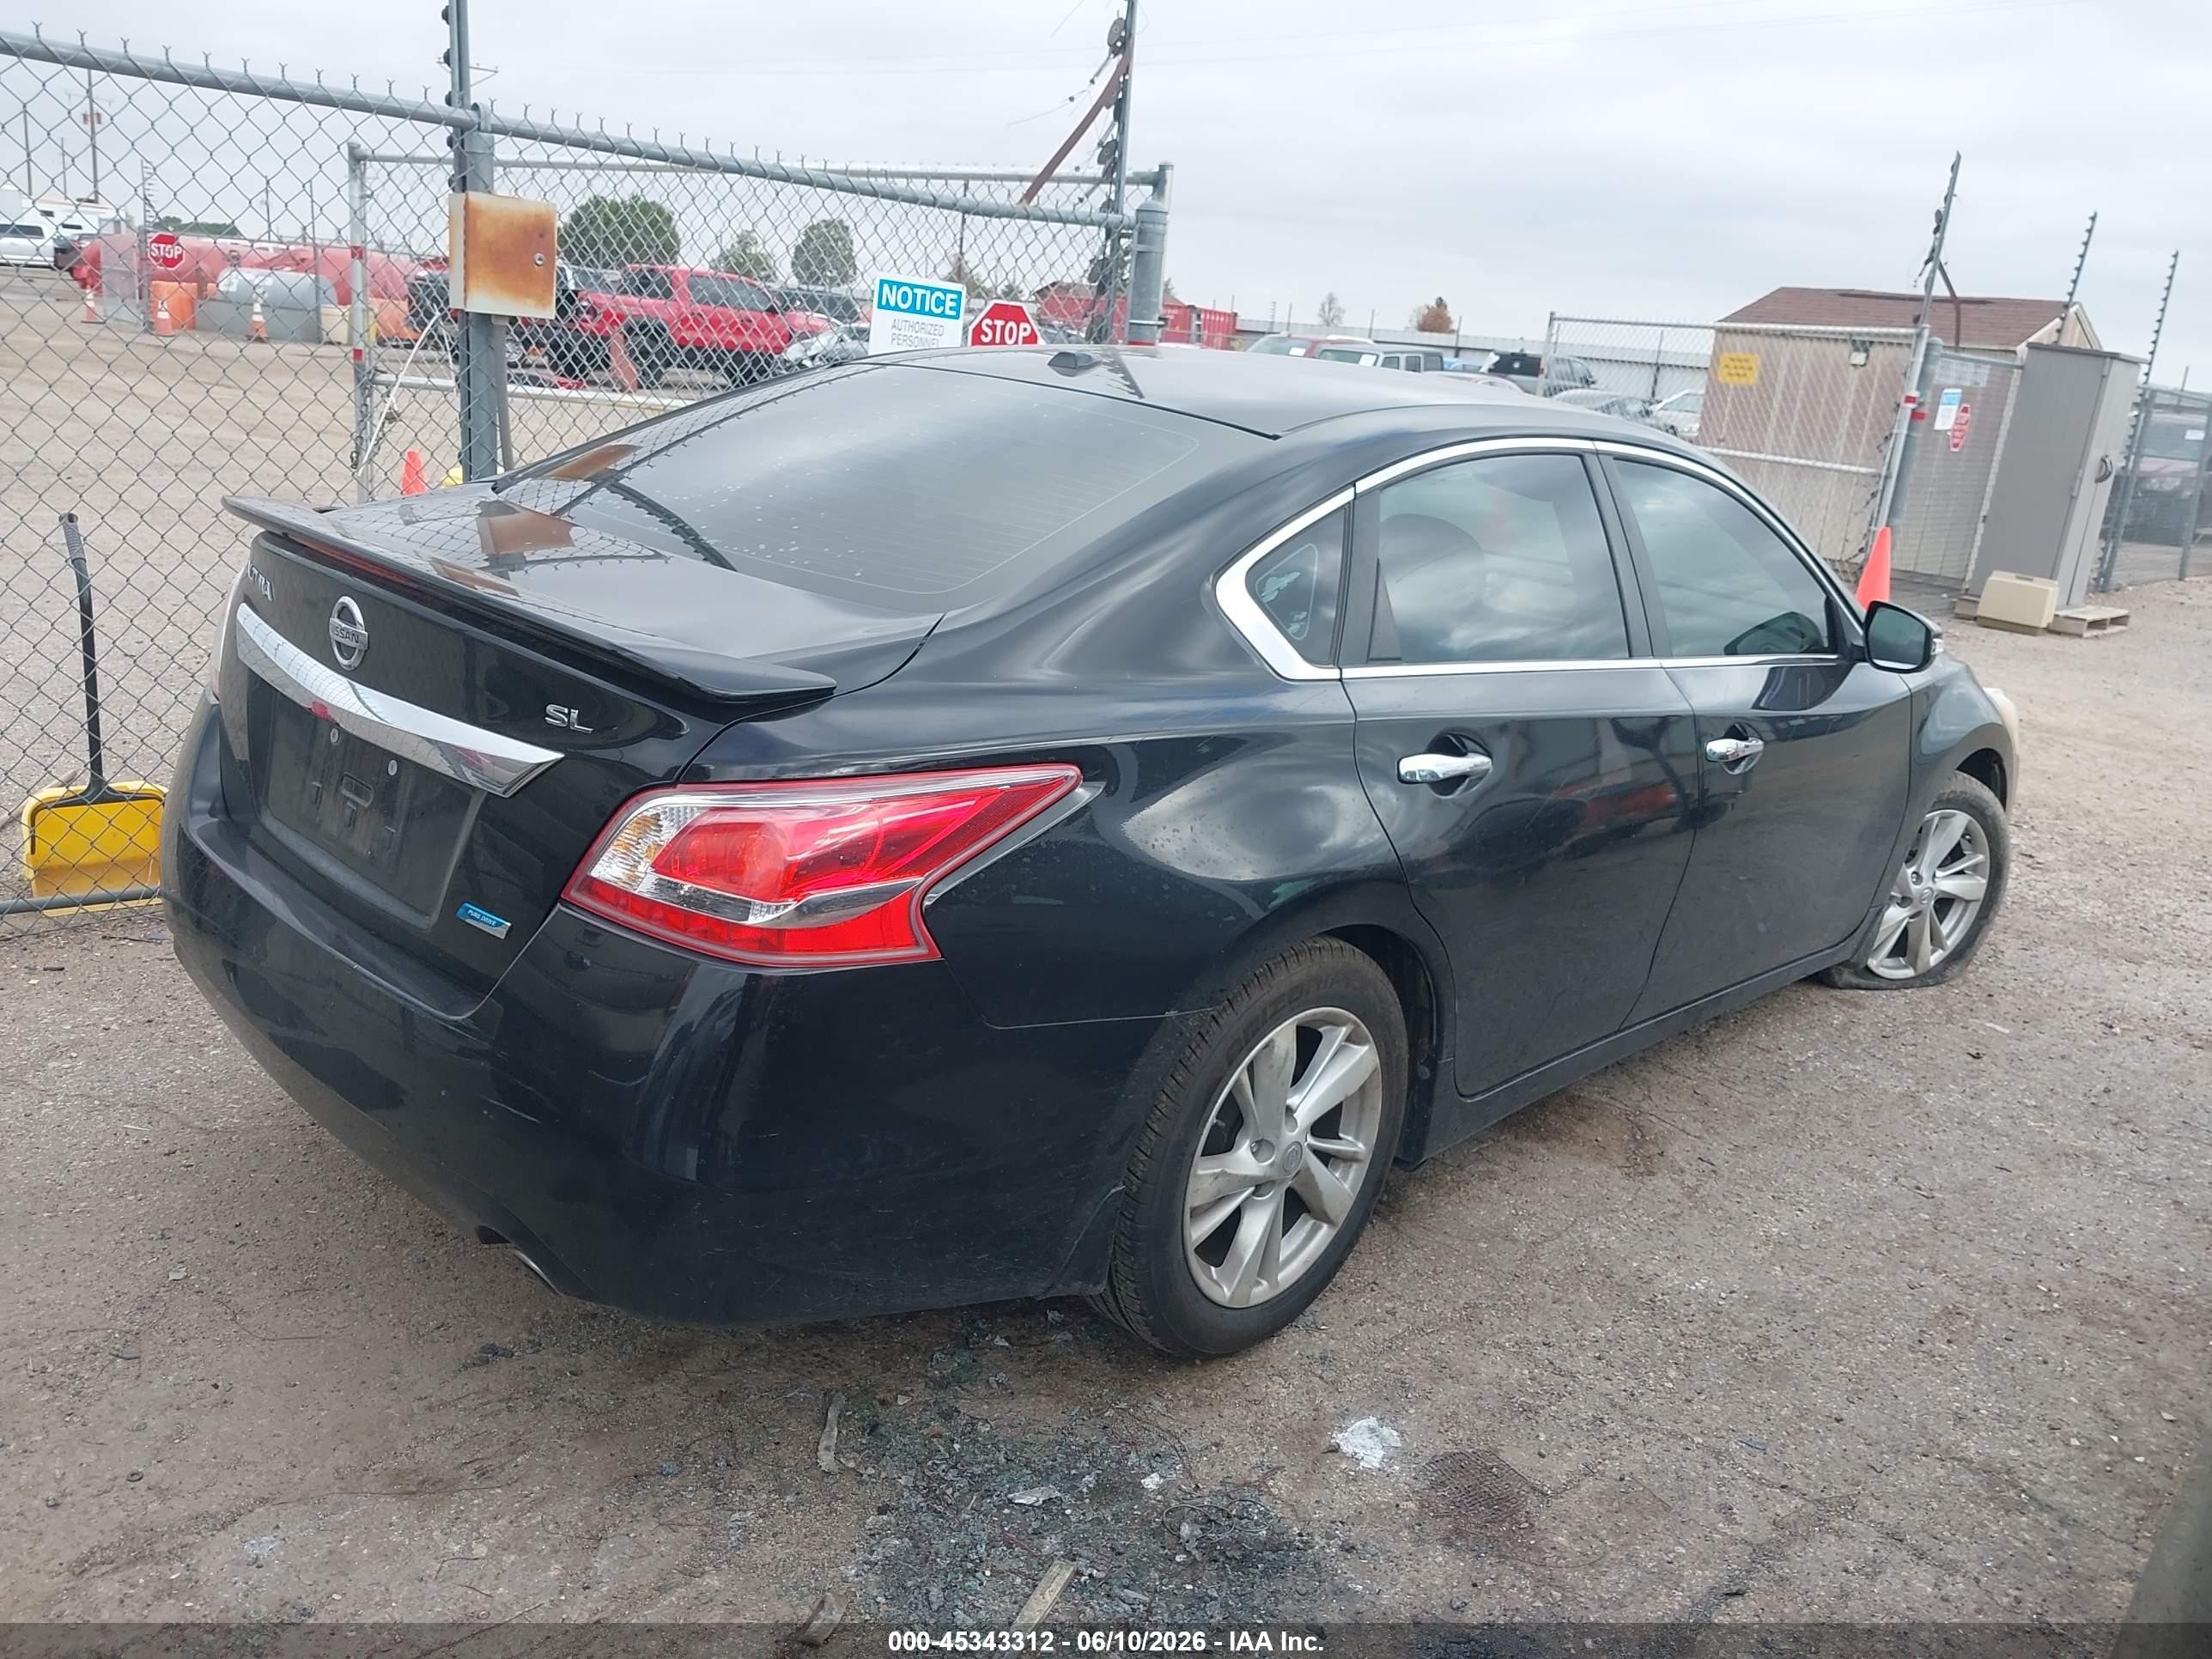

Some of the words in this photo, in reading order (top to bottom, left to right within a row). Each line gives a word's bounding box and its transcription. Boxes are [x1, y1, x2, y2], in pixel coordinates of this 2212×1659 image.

[150, 242, 182, 259] STOP
[881, 283, 958, 315] NOTICE
[890, 318, 945, 337] AUTHORIZED
[980, 318, 1032, 345] STOP
[890, 332, 939, 349] PERSONNEL
[544, 703, 593, 734] SL
[467, 908, 481, 920] PURE
[481, 915, 496, 927] DRIVE
